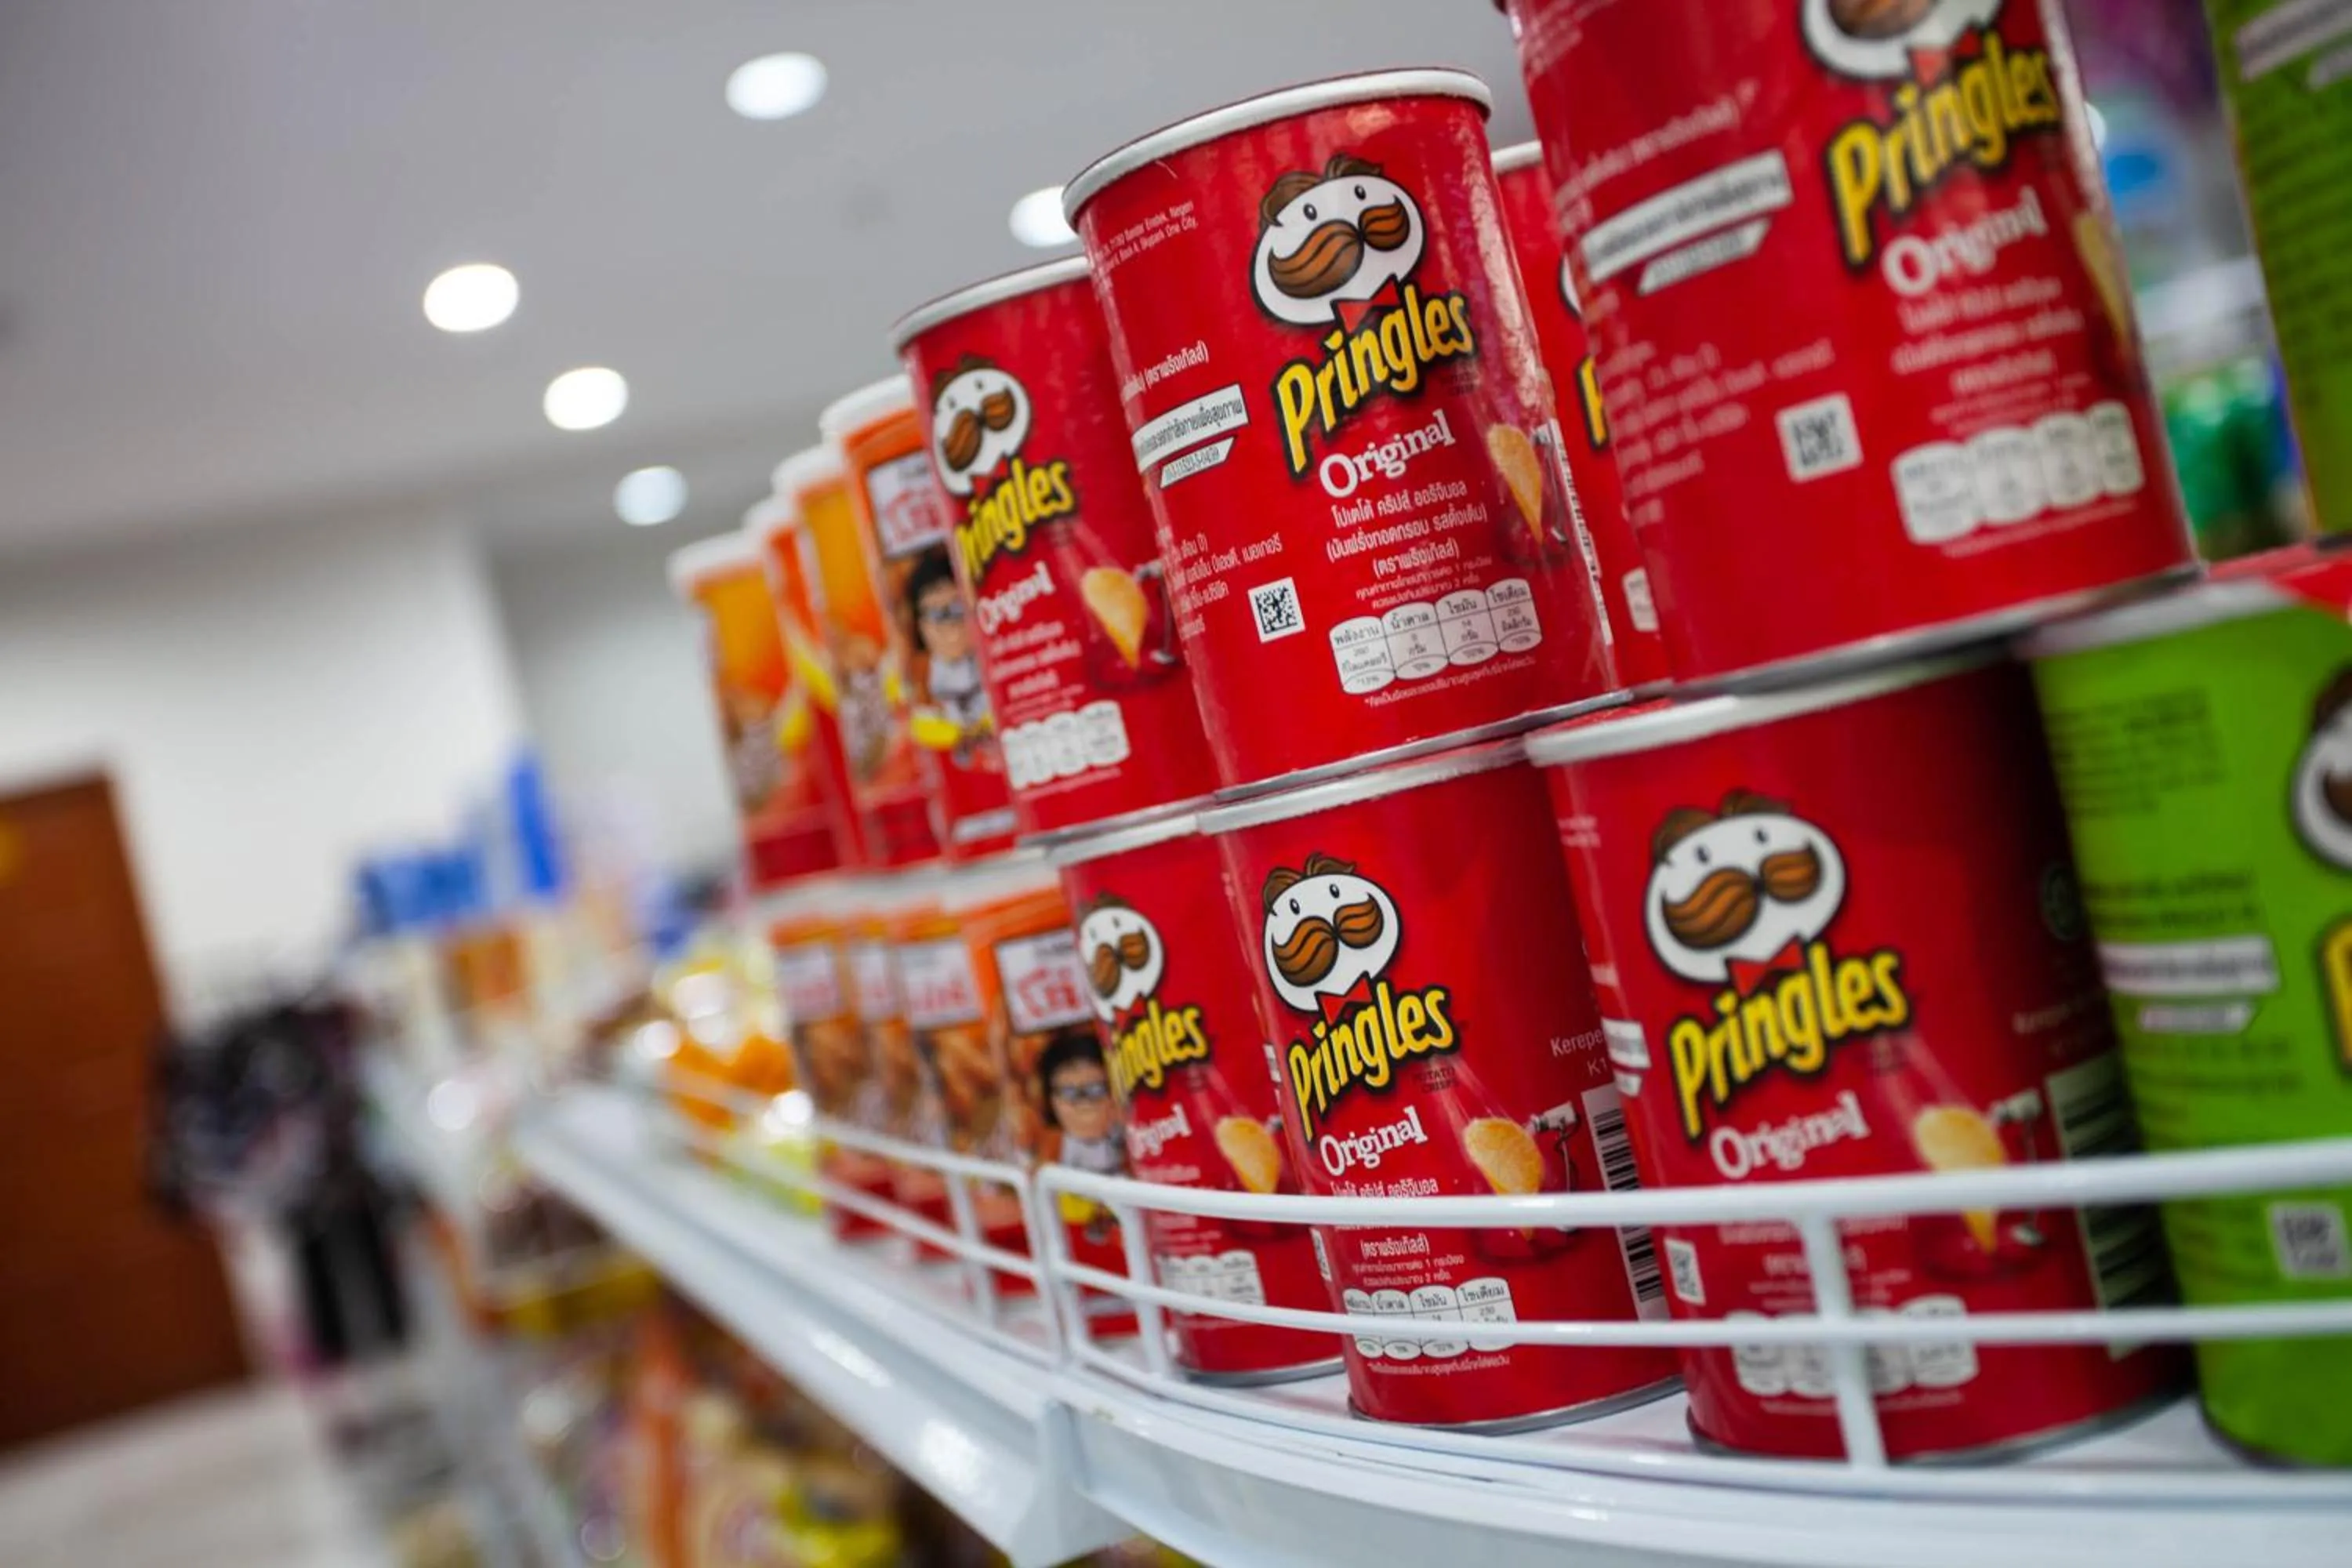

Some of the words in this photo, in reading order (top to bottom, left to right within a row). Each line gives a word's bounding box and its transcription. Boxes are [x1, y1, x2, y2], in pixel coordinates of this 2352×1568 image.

[1828, 32, 2059, 265] Pringles
[1276, 282, 1474, 474] Pringles
[1319, 408, 1456, 498] Original
[1288, 982, 1454, 1142] Pringles
[1550, 1029, 1603, 1058] Kerepe
[1670, 942, 1907, 1138] Pringles
[1319, 1105, 1428, 1176] Original
[1709, 1090, 1871, 1180] Original
